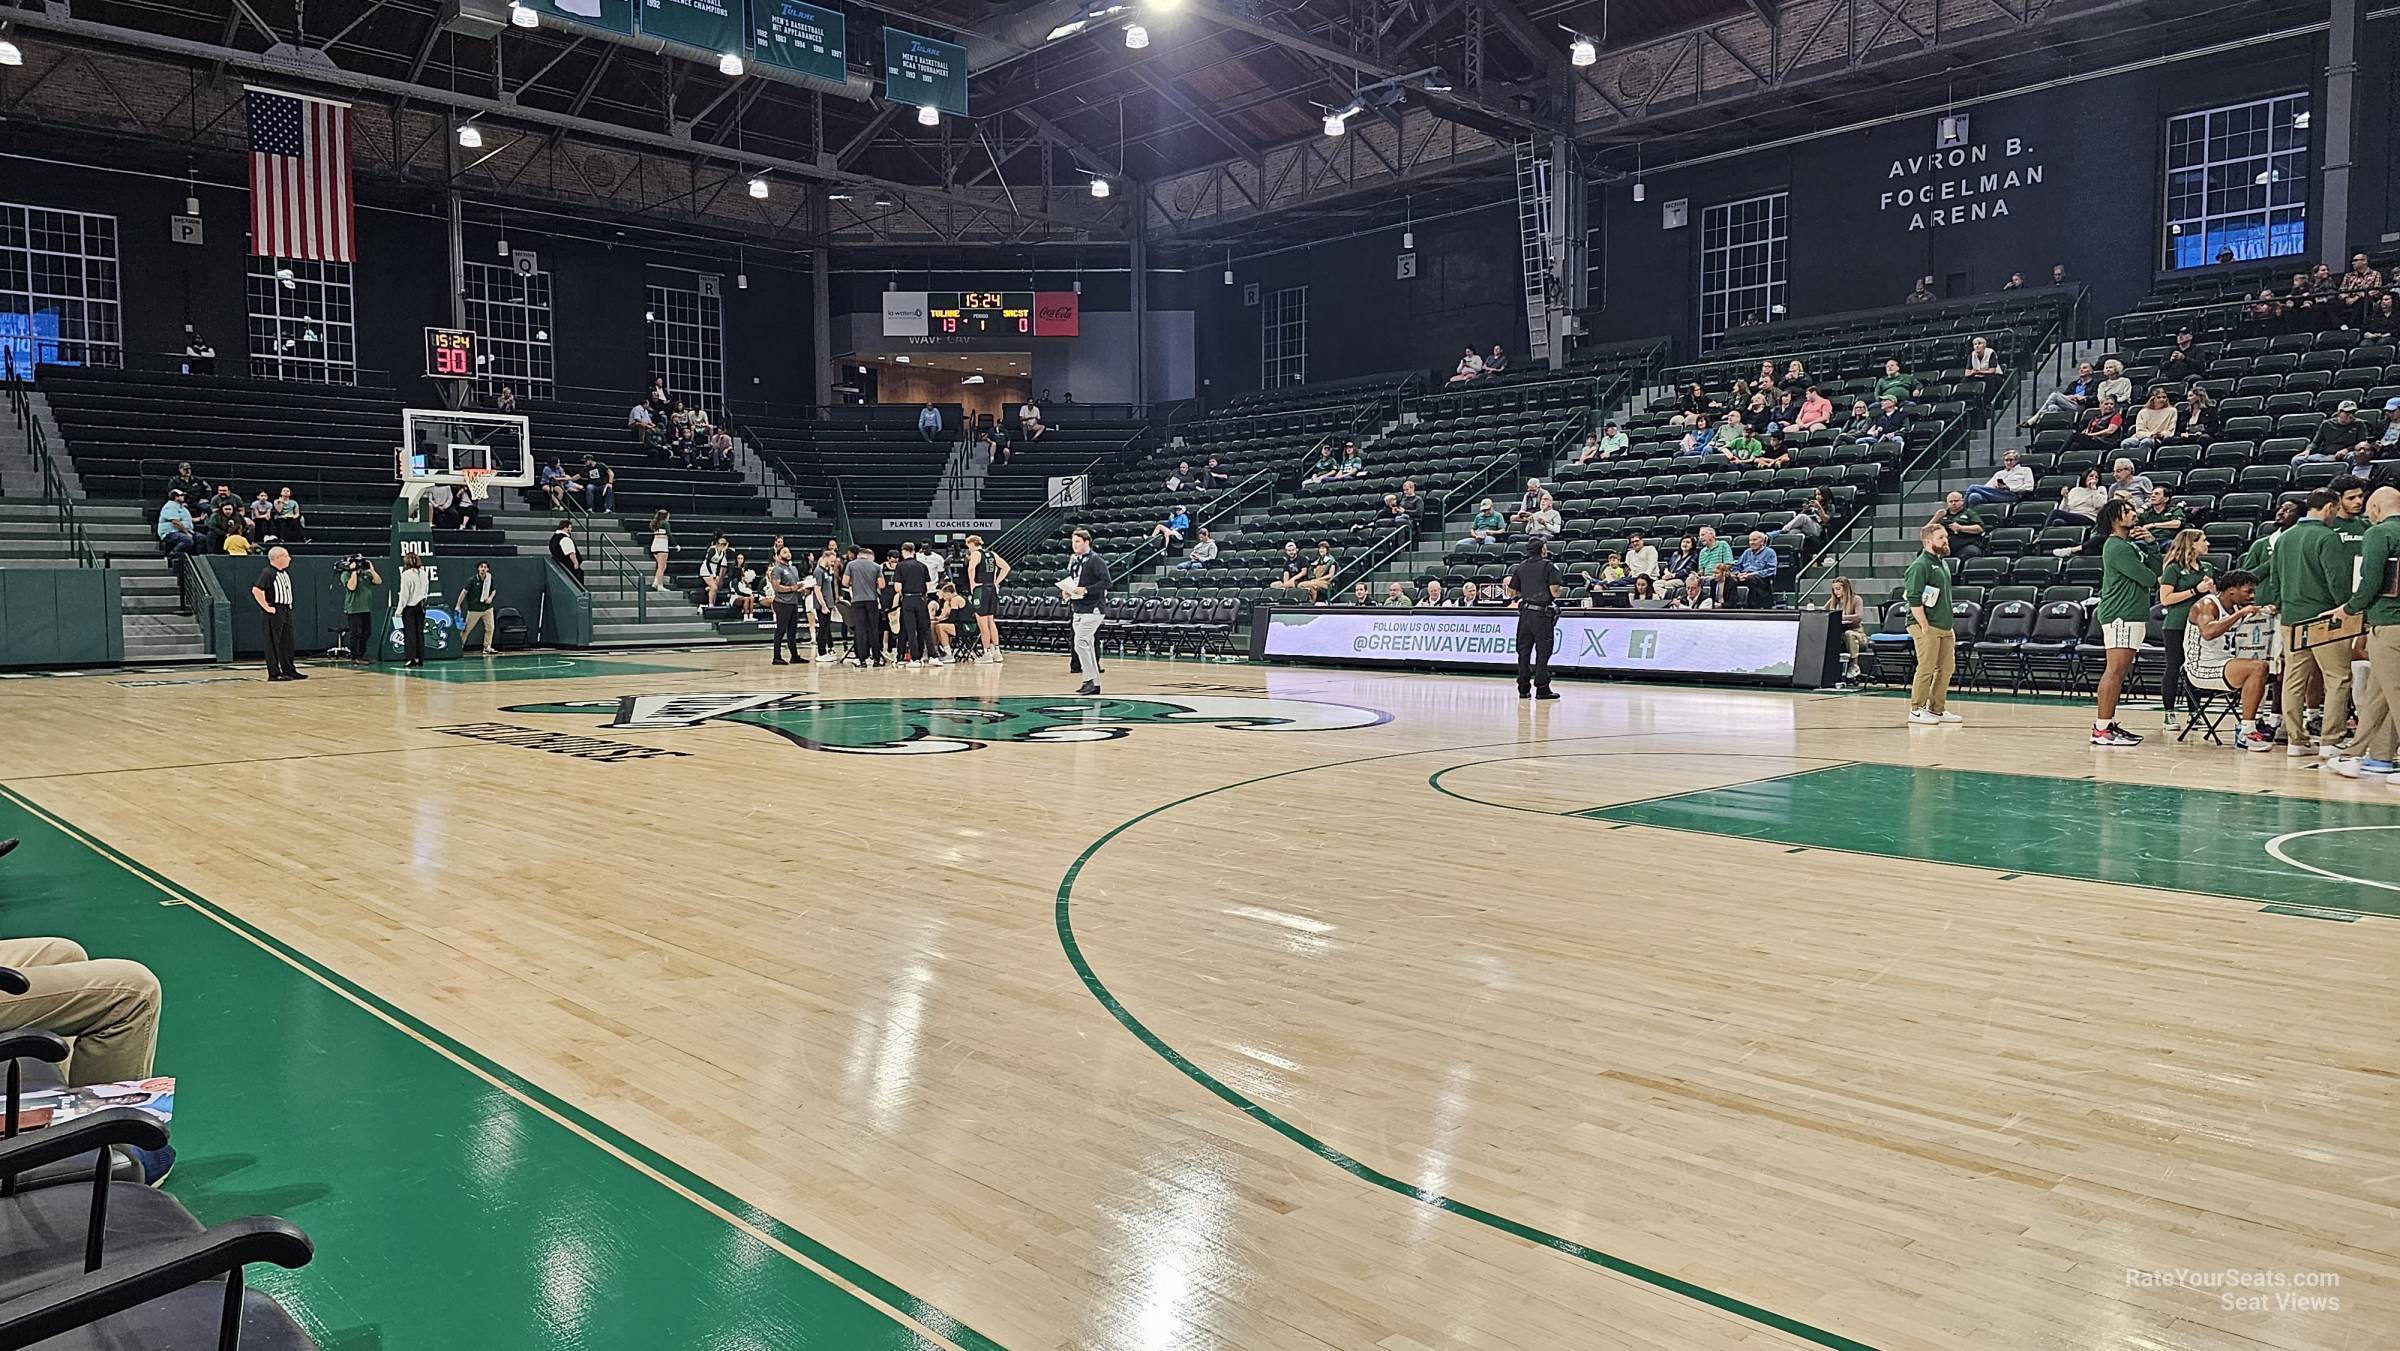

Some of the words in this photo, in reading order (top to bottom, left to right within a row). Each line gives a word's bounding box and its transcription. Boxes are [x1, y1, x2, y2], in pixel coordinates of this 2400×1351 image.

[646, 0, 661, 9] 1992
[694, 1, 728, 17] CHAMPIONS
[771, 15, 789, 27] MEN'S
[790, 20, 824, 36] BASKETBALL
[784, 27, 822, 43] APPEARANCES
[902, 53, 918, 62] MEN'S
[919, 57, 949, 70] BASKETBALL
[902, 60, 917, 70] NCAA
[917, 64, 949, 78] TOURNAMENT
[1889, 144, 1987, 178] AVRON
[2006, 137, 2034, 156] B.
[1880, 165, 2043, 210] FOGELMAN
[1909, 199, 2009, 231] ARENA
[182, 225, 194, 240] P
[519, 259, 531, 274] Q
[1403, 262, 1410, 275] S
[705, 283, 714, 295] R
[966, 293, 1001, 308] 15:24
[1248, 291, 1255, 303] R
[930, 309, 960, 318] TULANE
[943, 318, 956, 333] 13
[980, 320, 985, 331] 1
[1018, 318, 1028, 333] 0
[435, 334, 470, 349] 15:24
[437, 348, 467, 373] 30
[400, 541, 434, 556] ROLL
[398, 565, 439, 581] VE
[1373, 622, 1408, 631] FOLLOW
[1409, 622, 1421, 632] US
[1423, 623, 1436, 632] ON
[1438, 623, 1471, 633] SOCIAL
[1472, 624, 1501, 634] MEDIA
[415, 721, 695, 763] FIELDHOUSE
